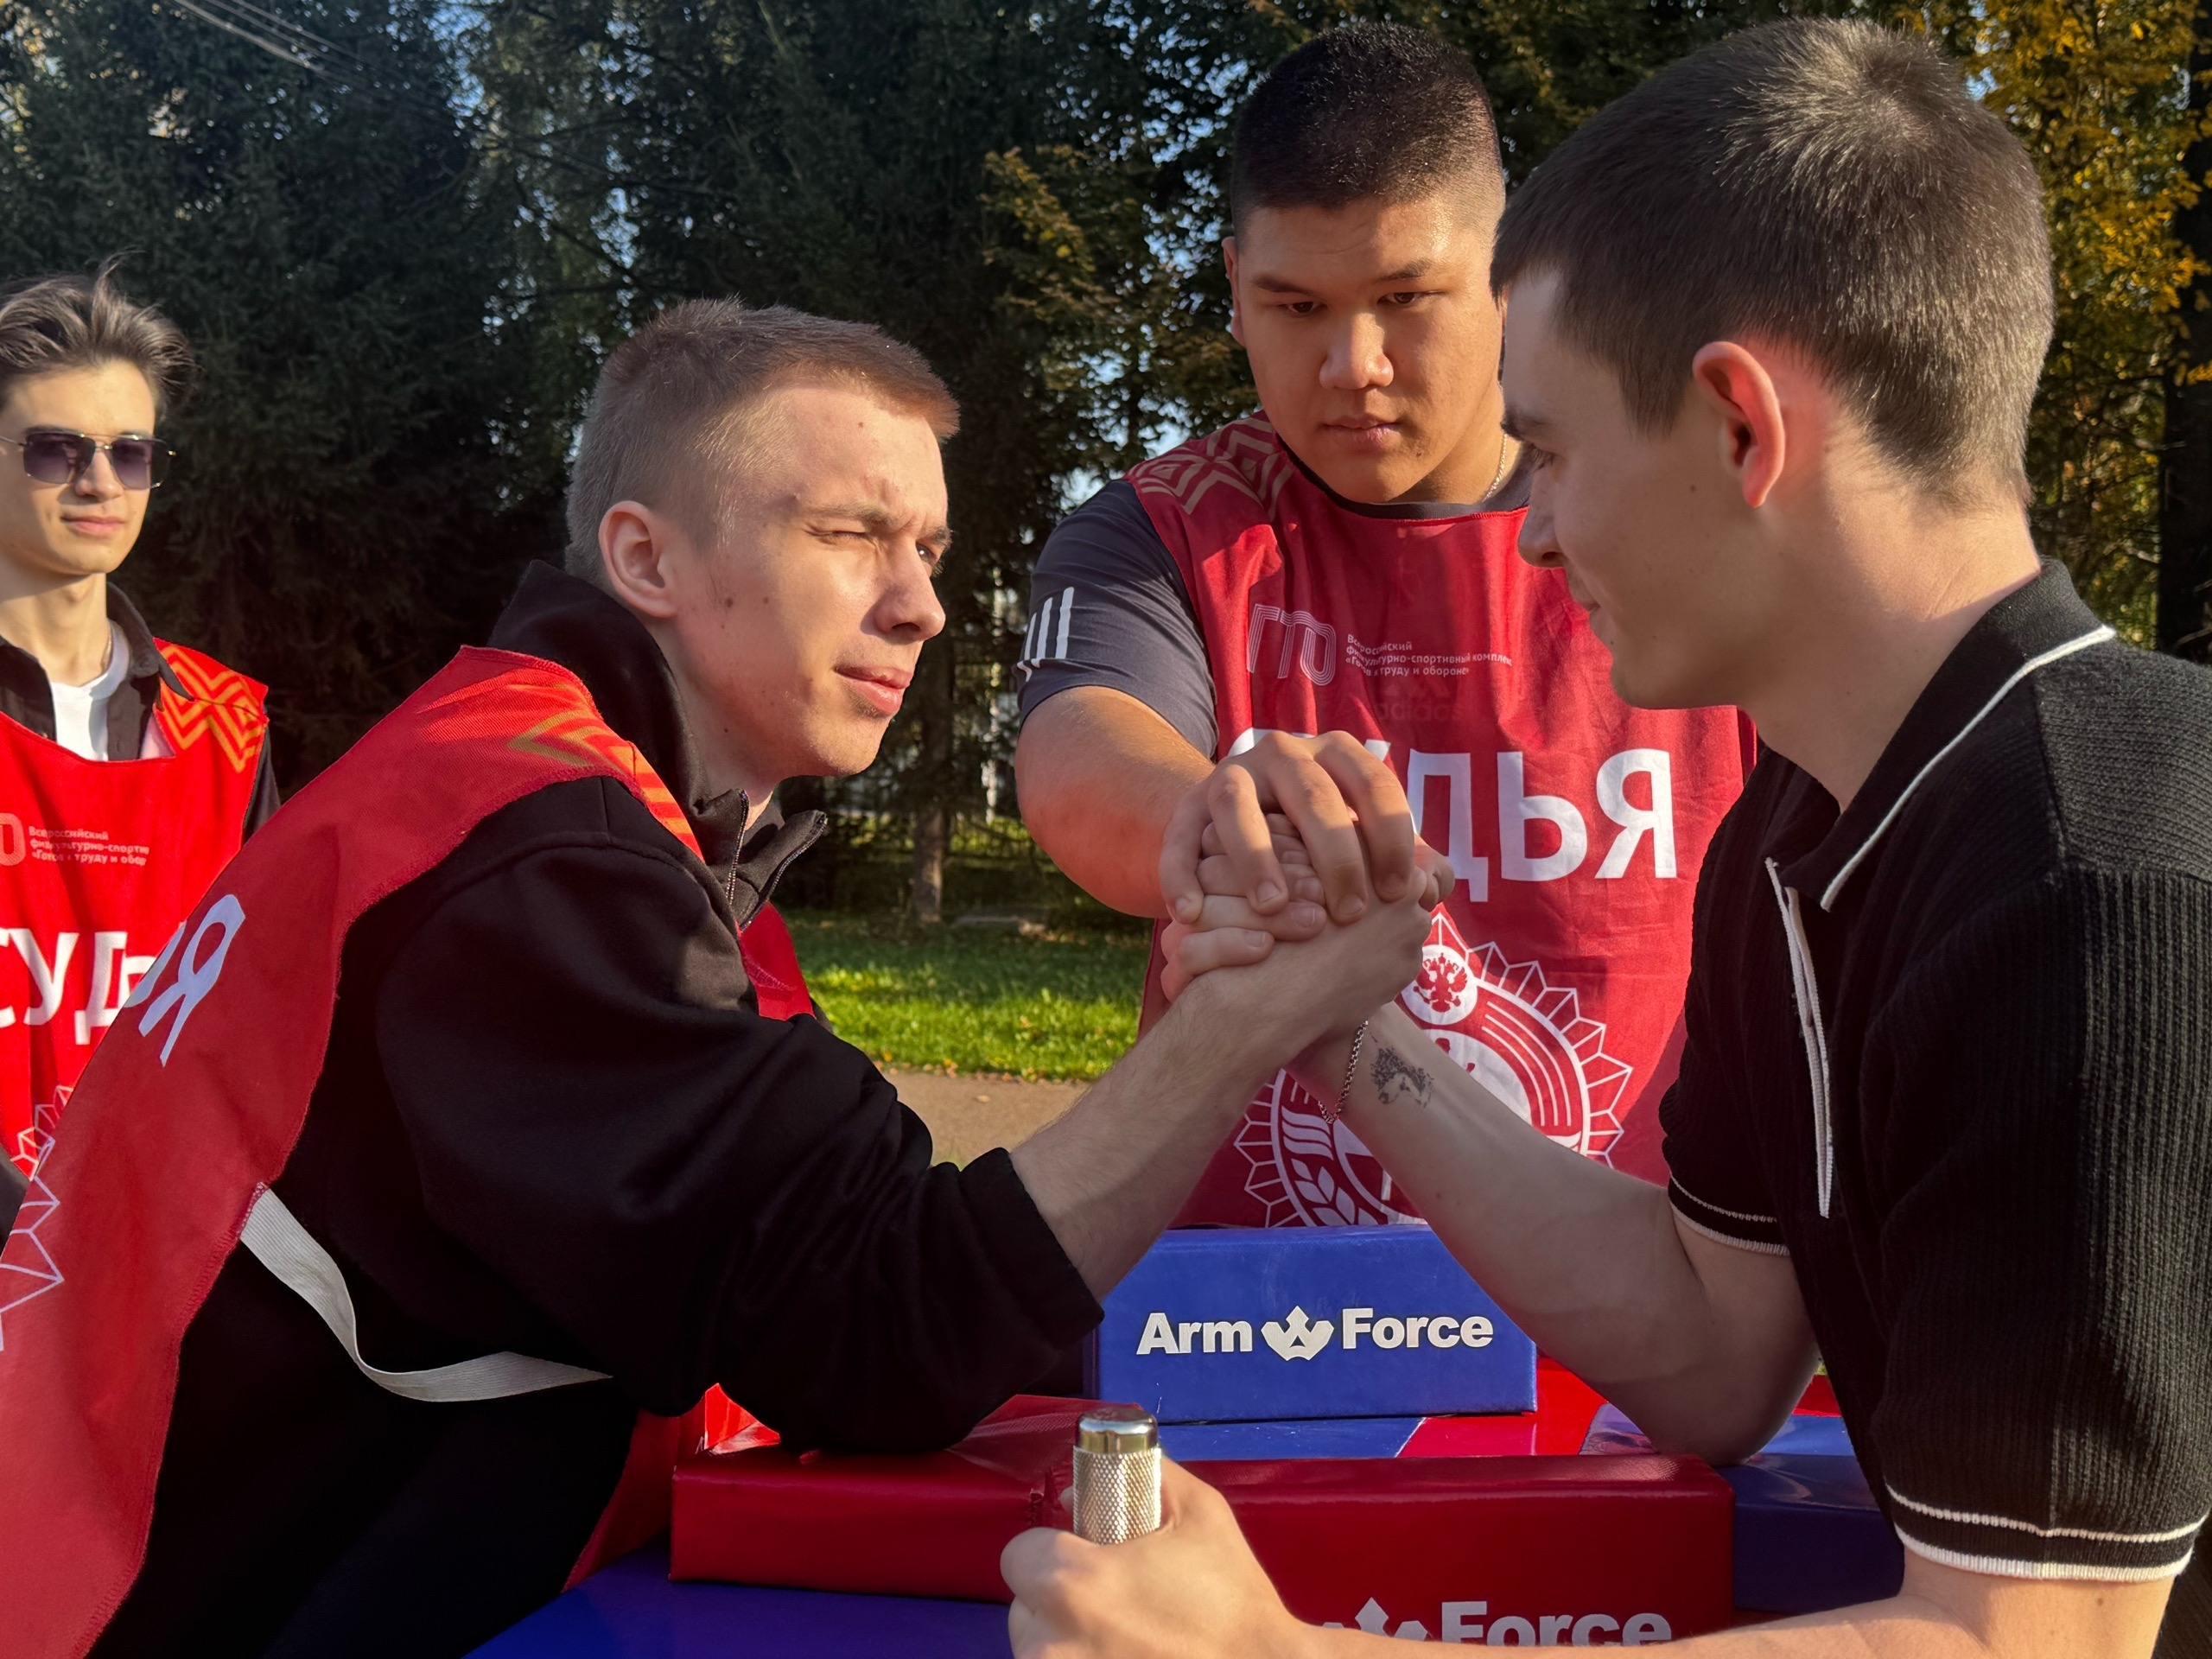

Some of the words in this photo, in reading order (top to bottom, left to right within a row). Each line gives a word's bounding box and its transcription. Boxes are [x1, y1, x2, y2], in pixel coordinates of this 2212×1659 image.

[1380, 667, 1410, 677] труду
[1228, 728, 1677, 903] ДЬЯ
[1136, 1313, 1253, 1355] Arm
[1343, 1307, 1494, 1349] Force
[1441, 1600, 1672, 1647] Force
